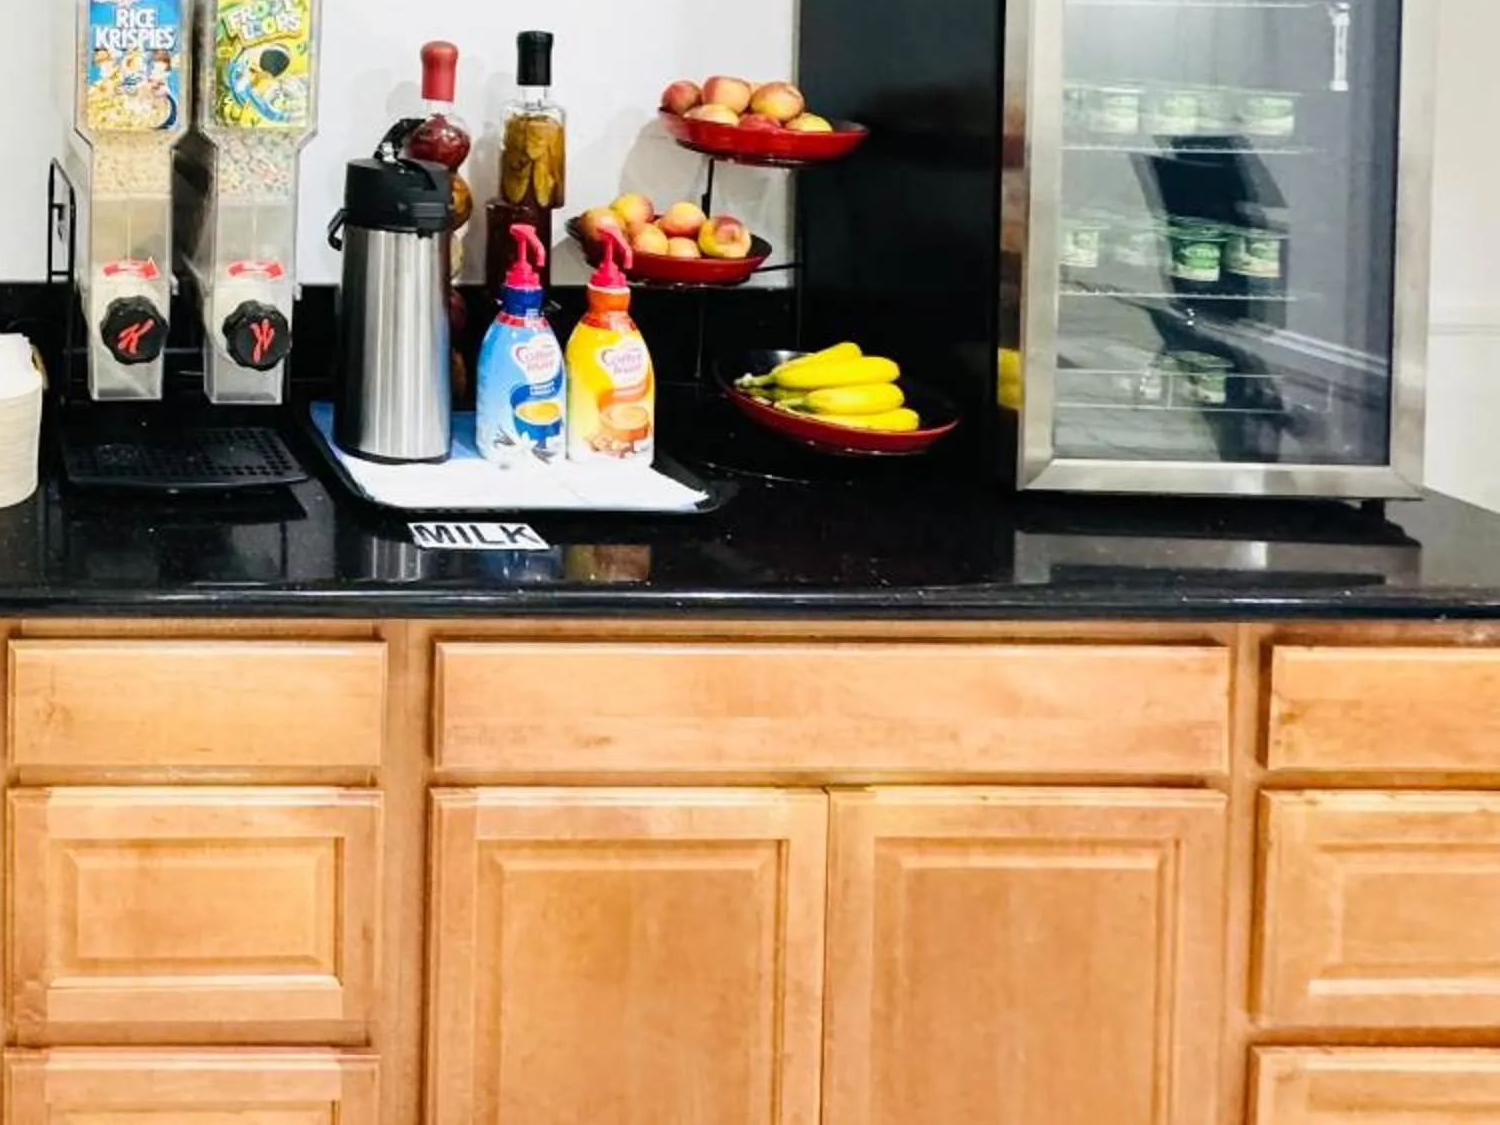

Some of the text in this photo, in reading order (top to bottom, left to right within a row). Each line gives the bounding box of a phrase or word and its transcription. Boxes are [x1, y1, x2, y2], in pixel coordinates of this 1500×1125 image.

[115, 8, 156, 28] RICE
[95, 26, 177, 51] KRISPIES
[413, 524, 541, 545] MILK
